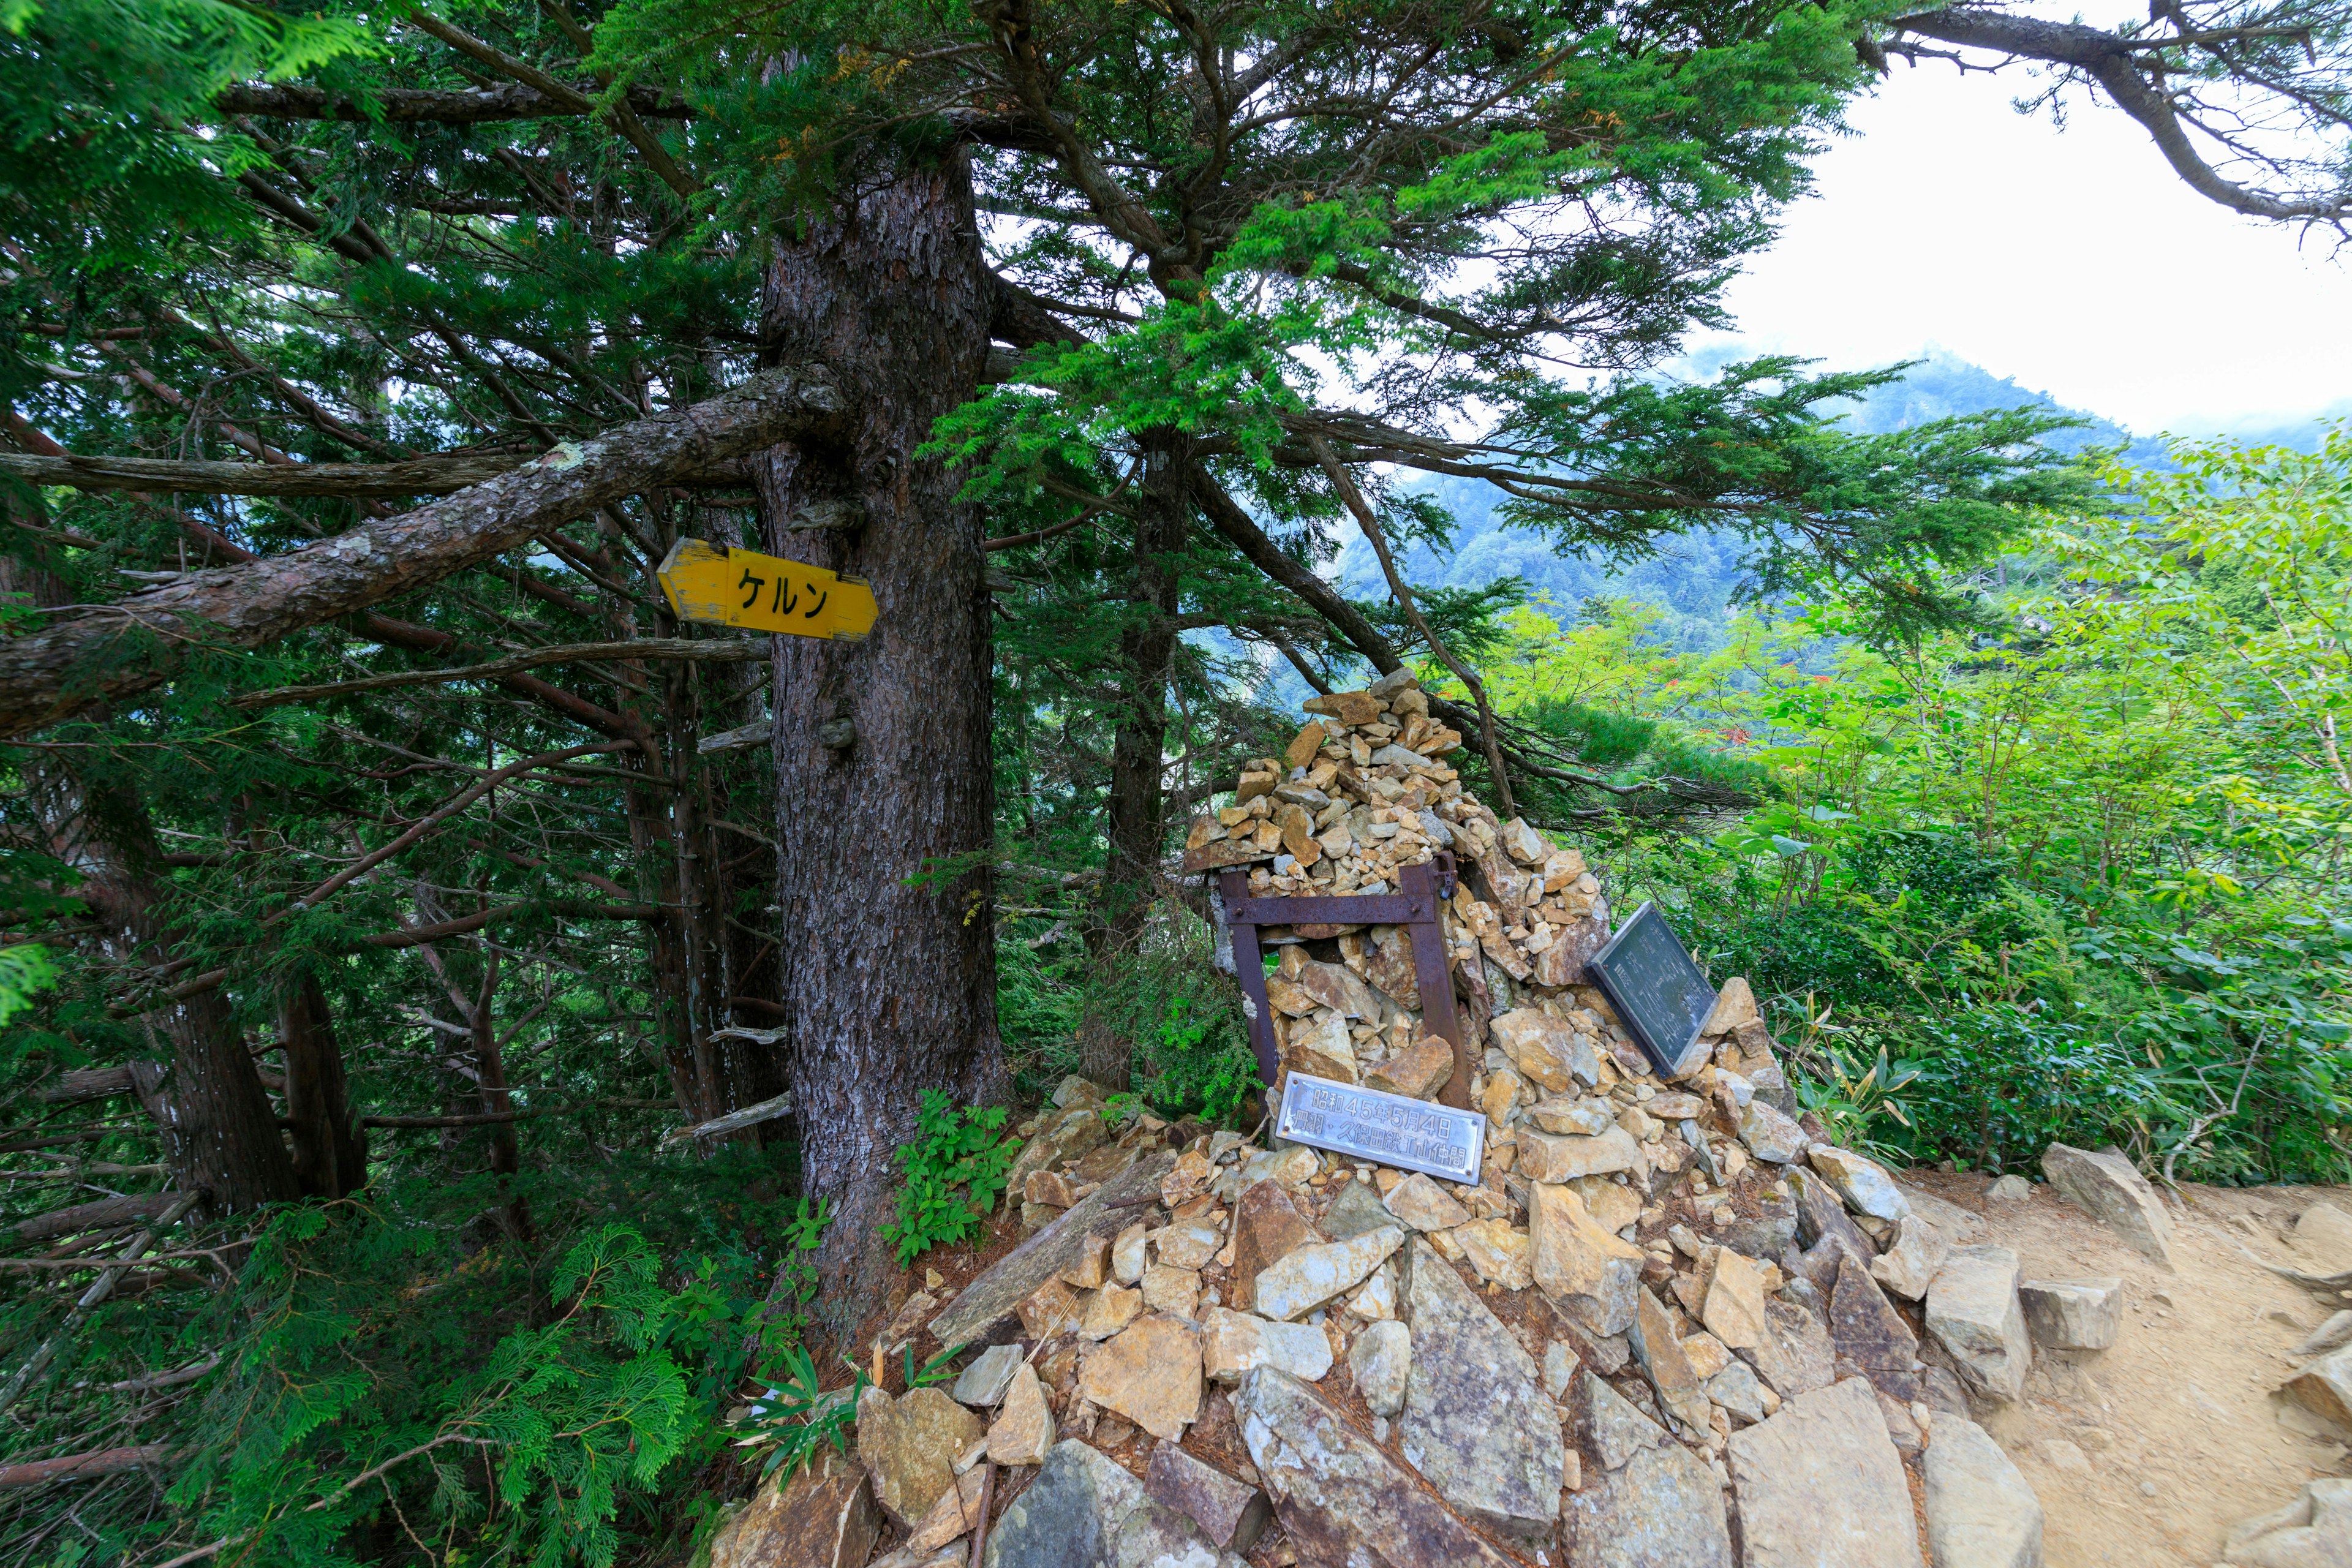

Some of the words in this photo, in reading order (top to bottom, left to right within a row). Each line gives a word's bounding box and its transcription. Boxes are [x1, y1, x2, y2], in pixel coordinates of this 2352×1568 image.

[738, 567, 827, 619] ケルン
[1311, 1088, 1452, 1140] 昭和45年5月4日
